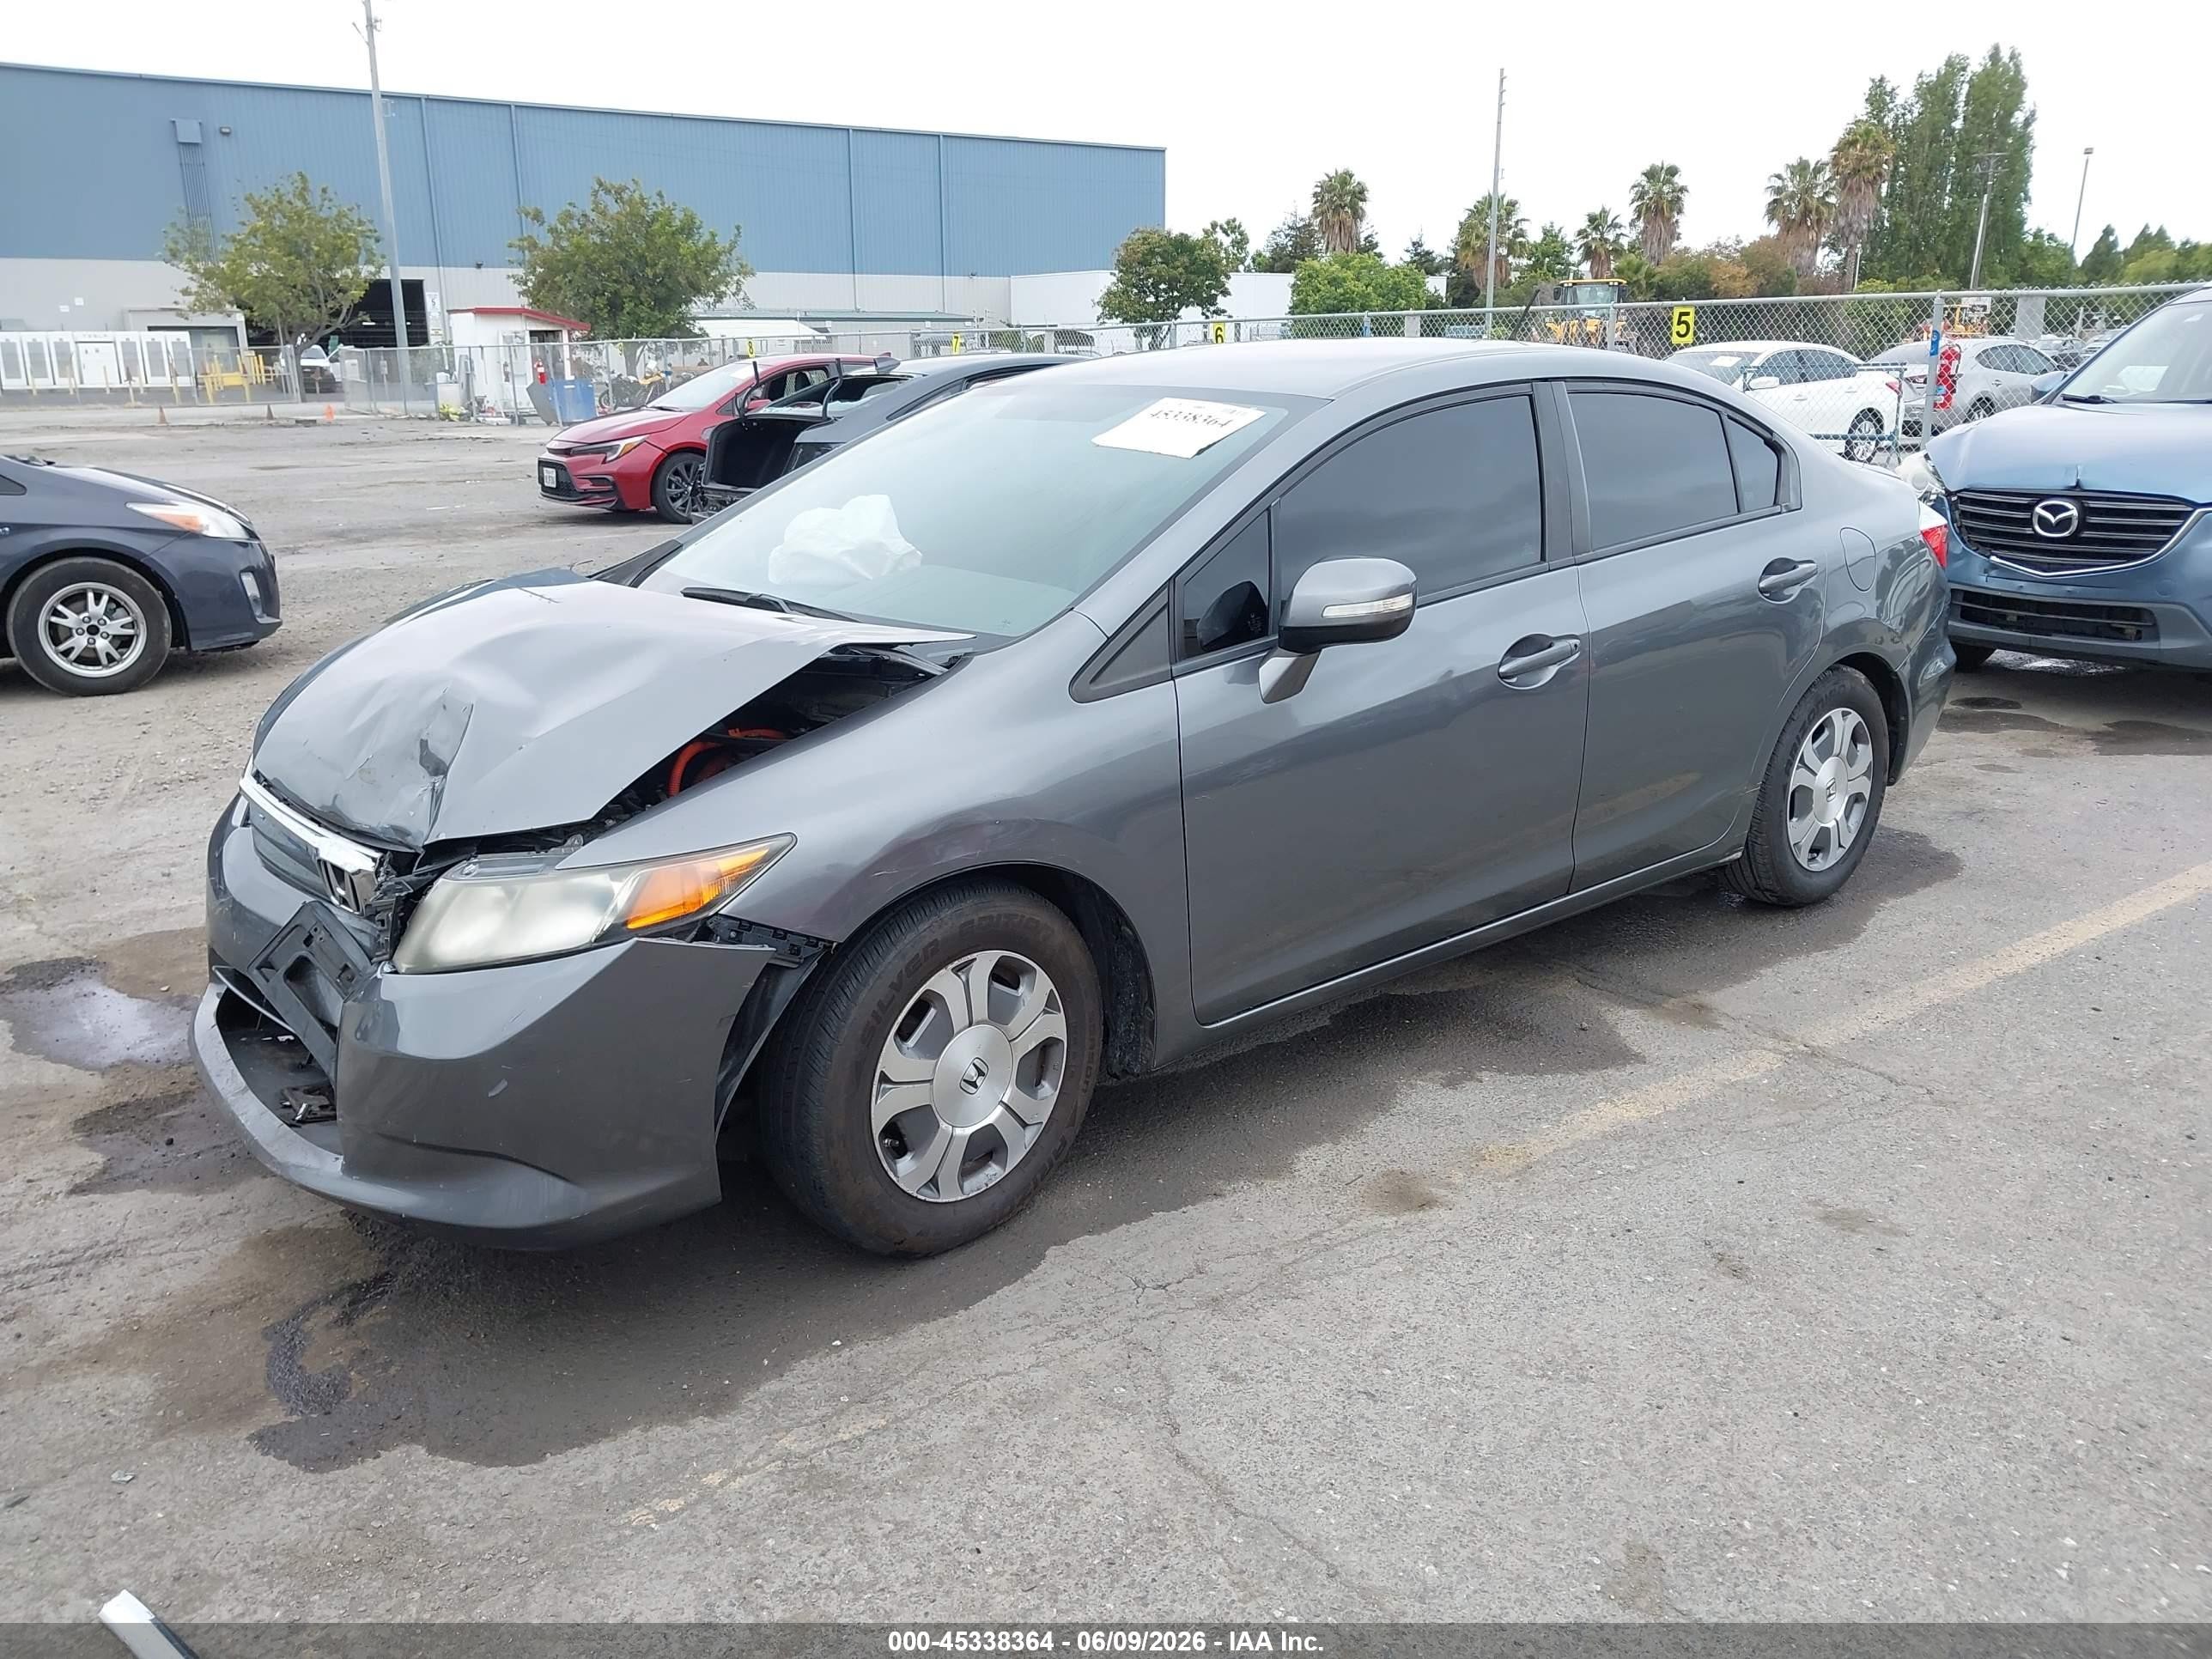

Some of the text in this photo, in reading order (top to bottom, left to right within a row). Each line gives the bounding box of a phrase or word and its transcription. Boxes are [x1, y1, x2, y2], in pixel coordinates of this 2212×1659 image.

[1675, 311, 1691, 338] 5
[1215, 326, 1224, 343] 6
[748, 341, 754, 355] 8
[953, 336, 958, 352] 7
